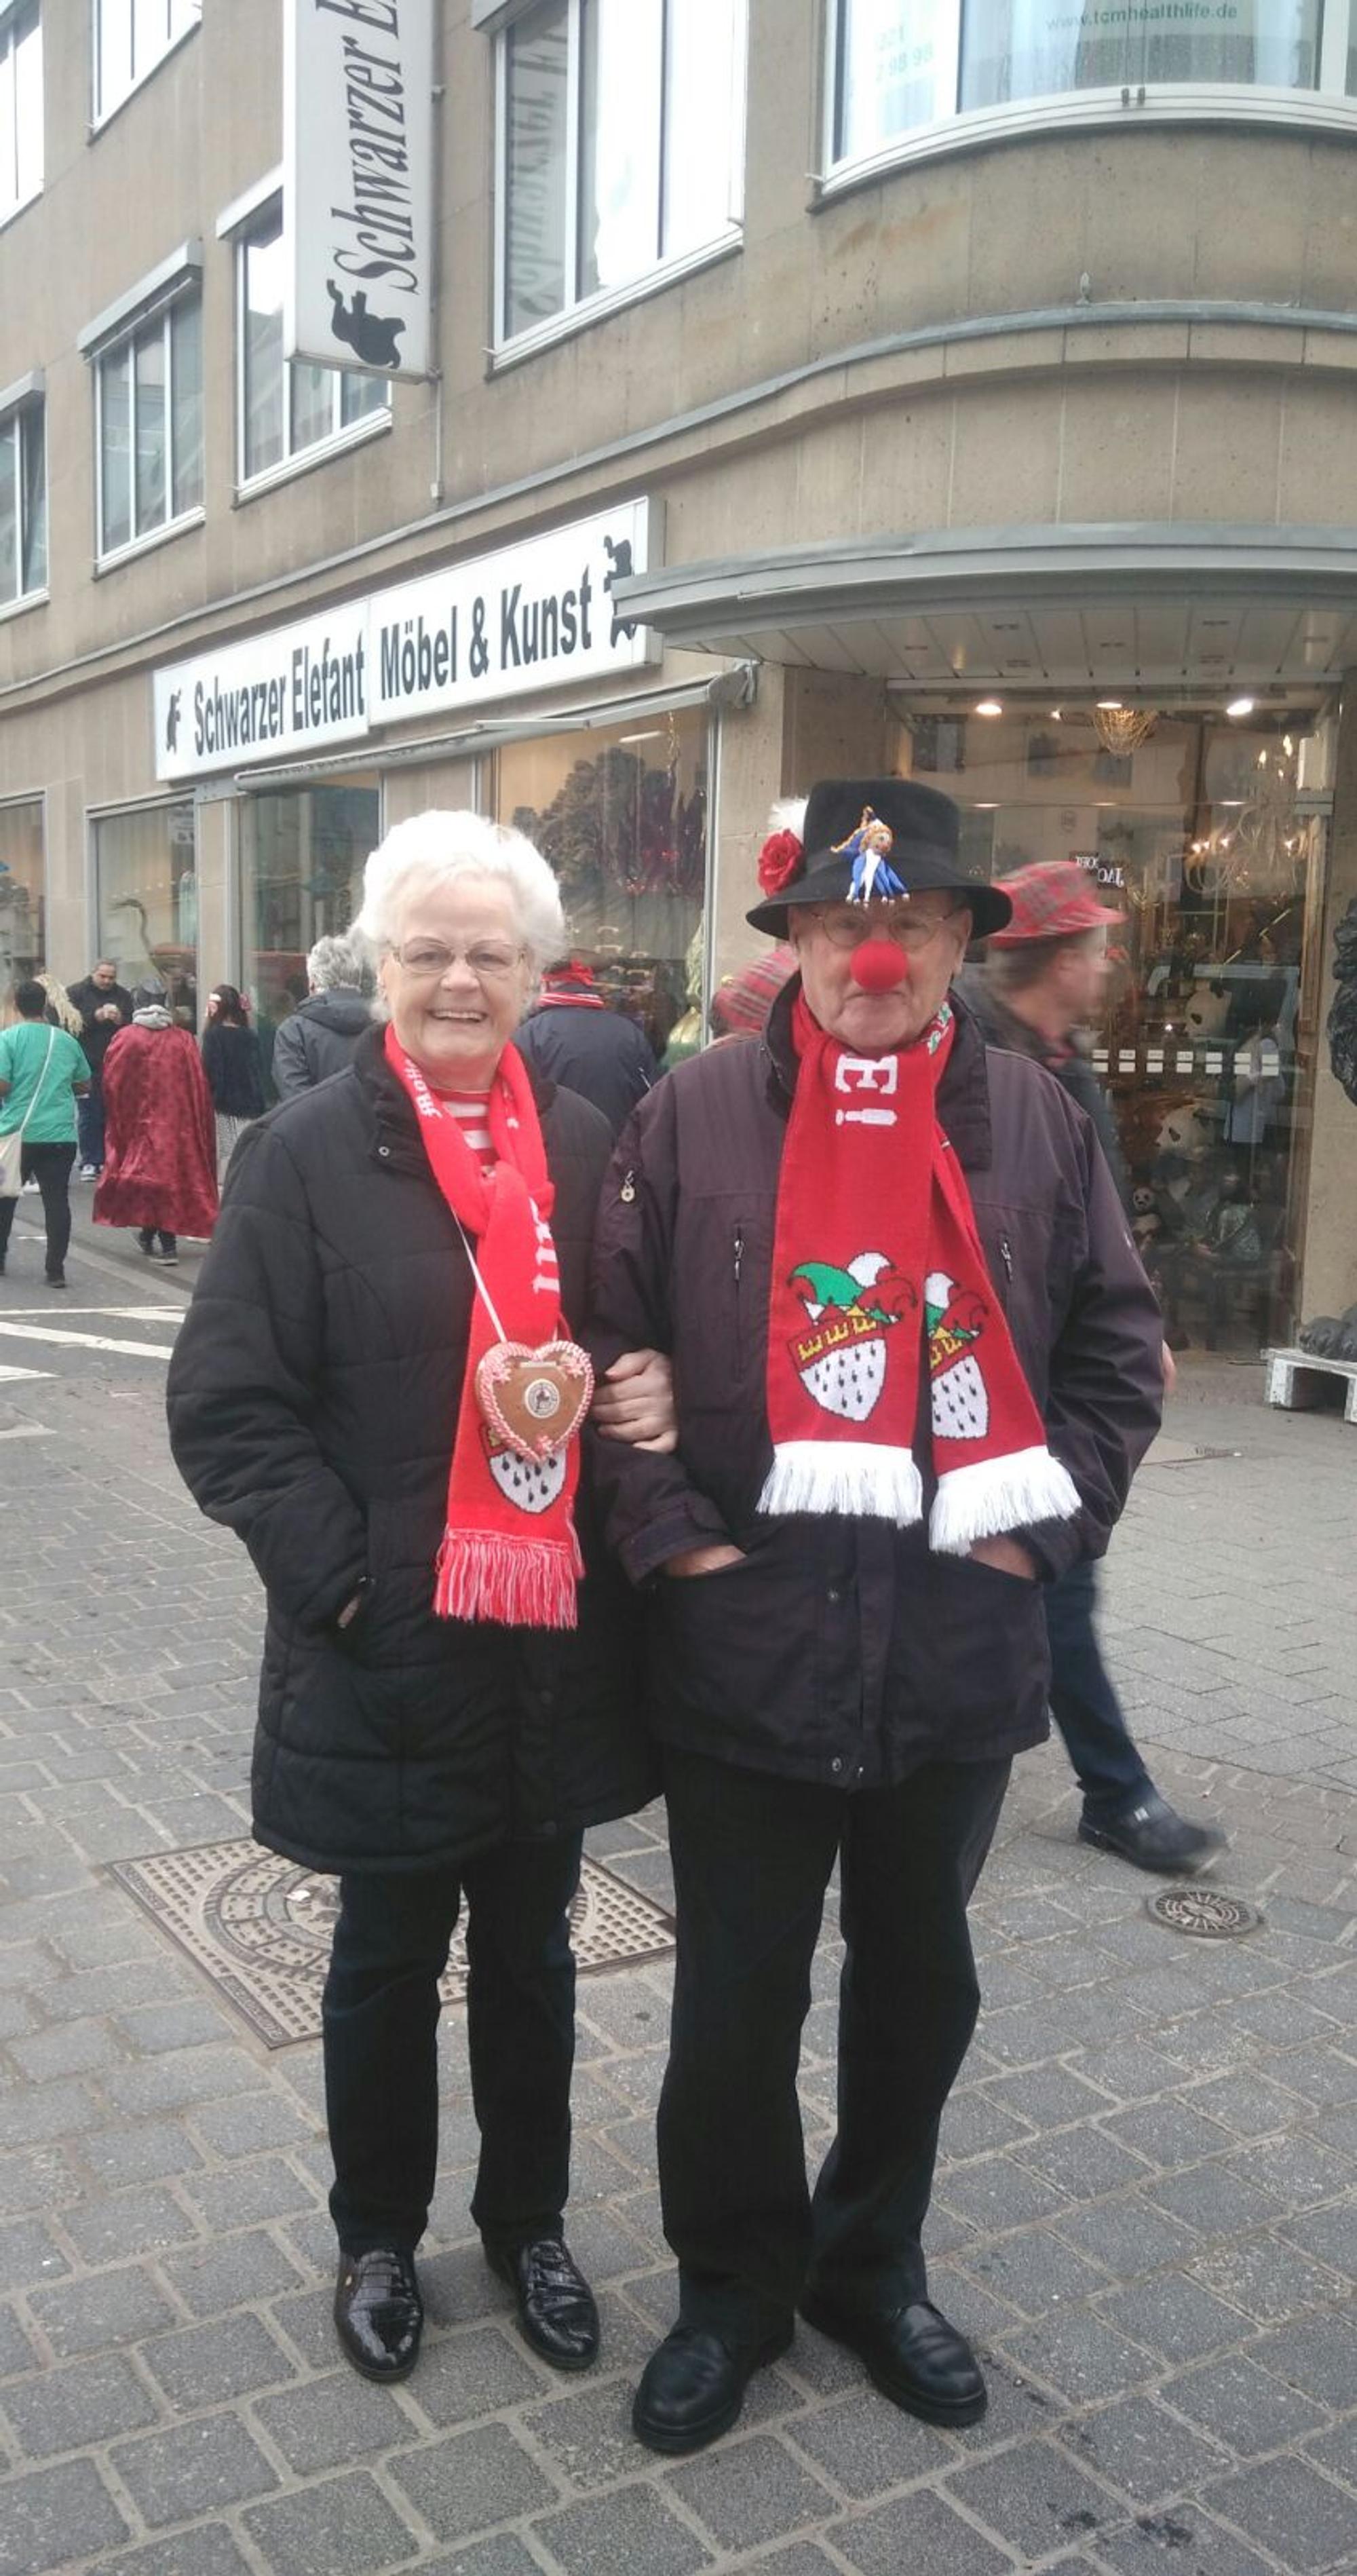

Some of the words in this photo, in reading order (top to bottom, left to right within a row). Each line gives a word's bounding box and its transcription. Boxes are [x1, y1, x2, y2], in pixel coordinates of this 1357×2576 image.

[316, 0, 399, 39] E
[330, 35, 419, 295] Schwarzer
[195, 675, 286, 757] Schwarzer
[292, 628, 365, 732] Elefant
[381, 605, 457, 701] Möbel
[469, 596, 489, 679] &
[501, 563, 592, 670] Kunst
